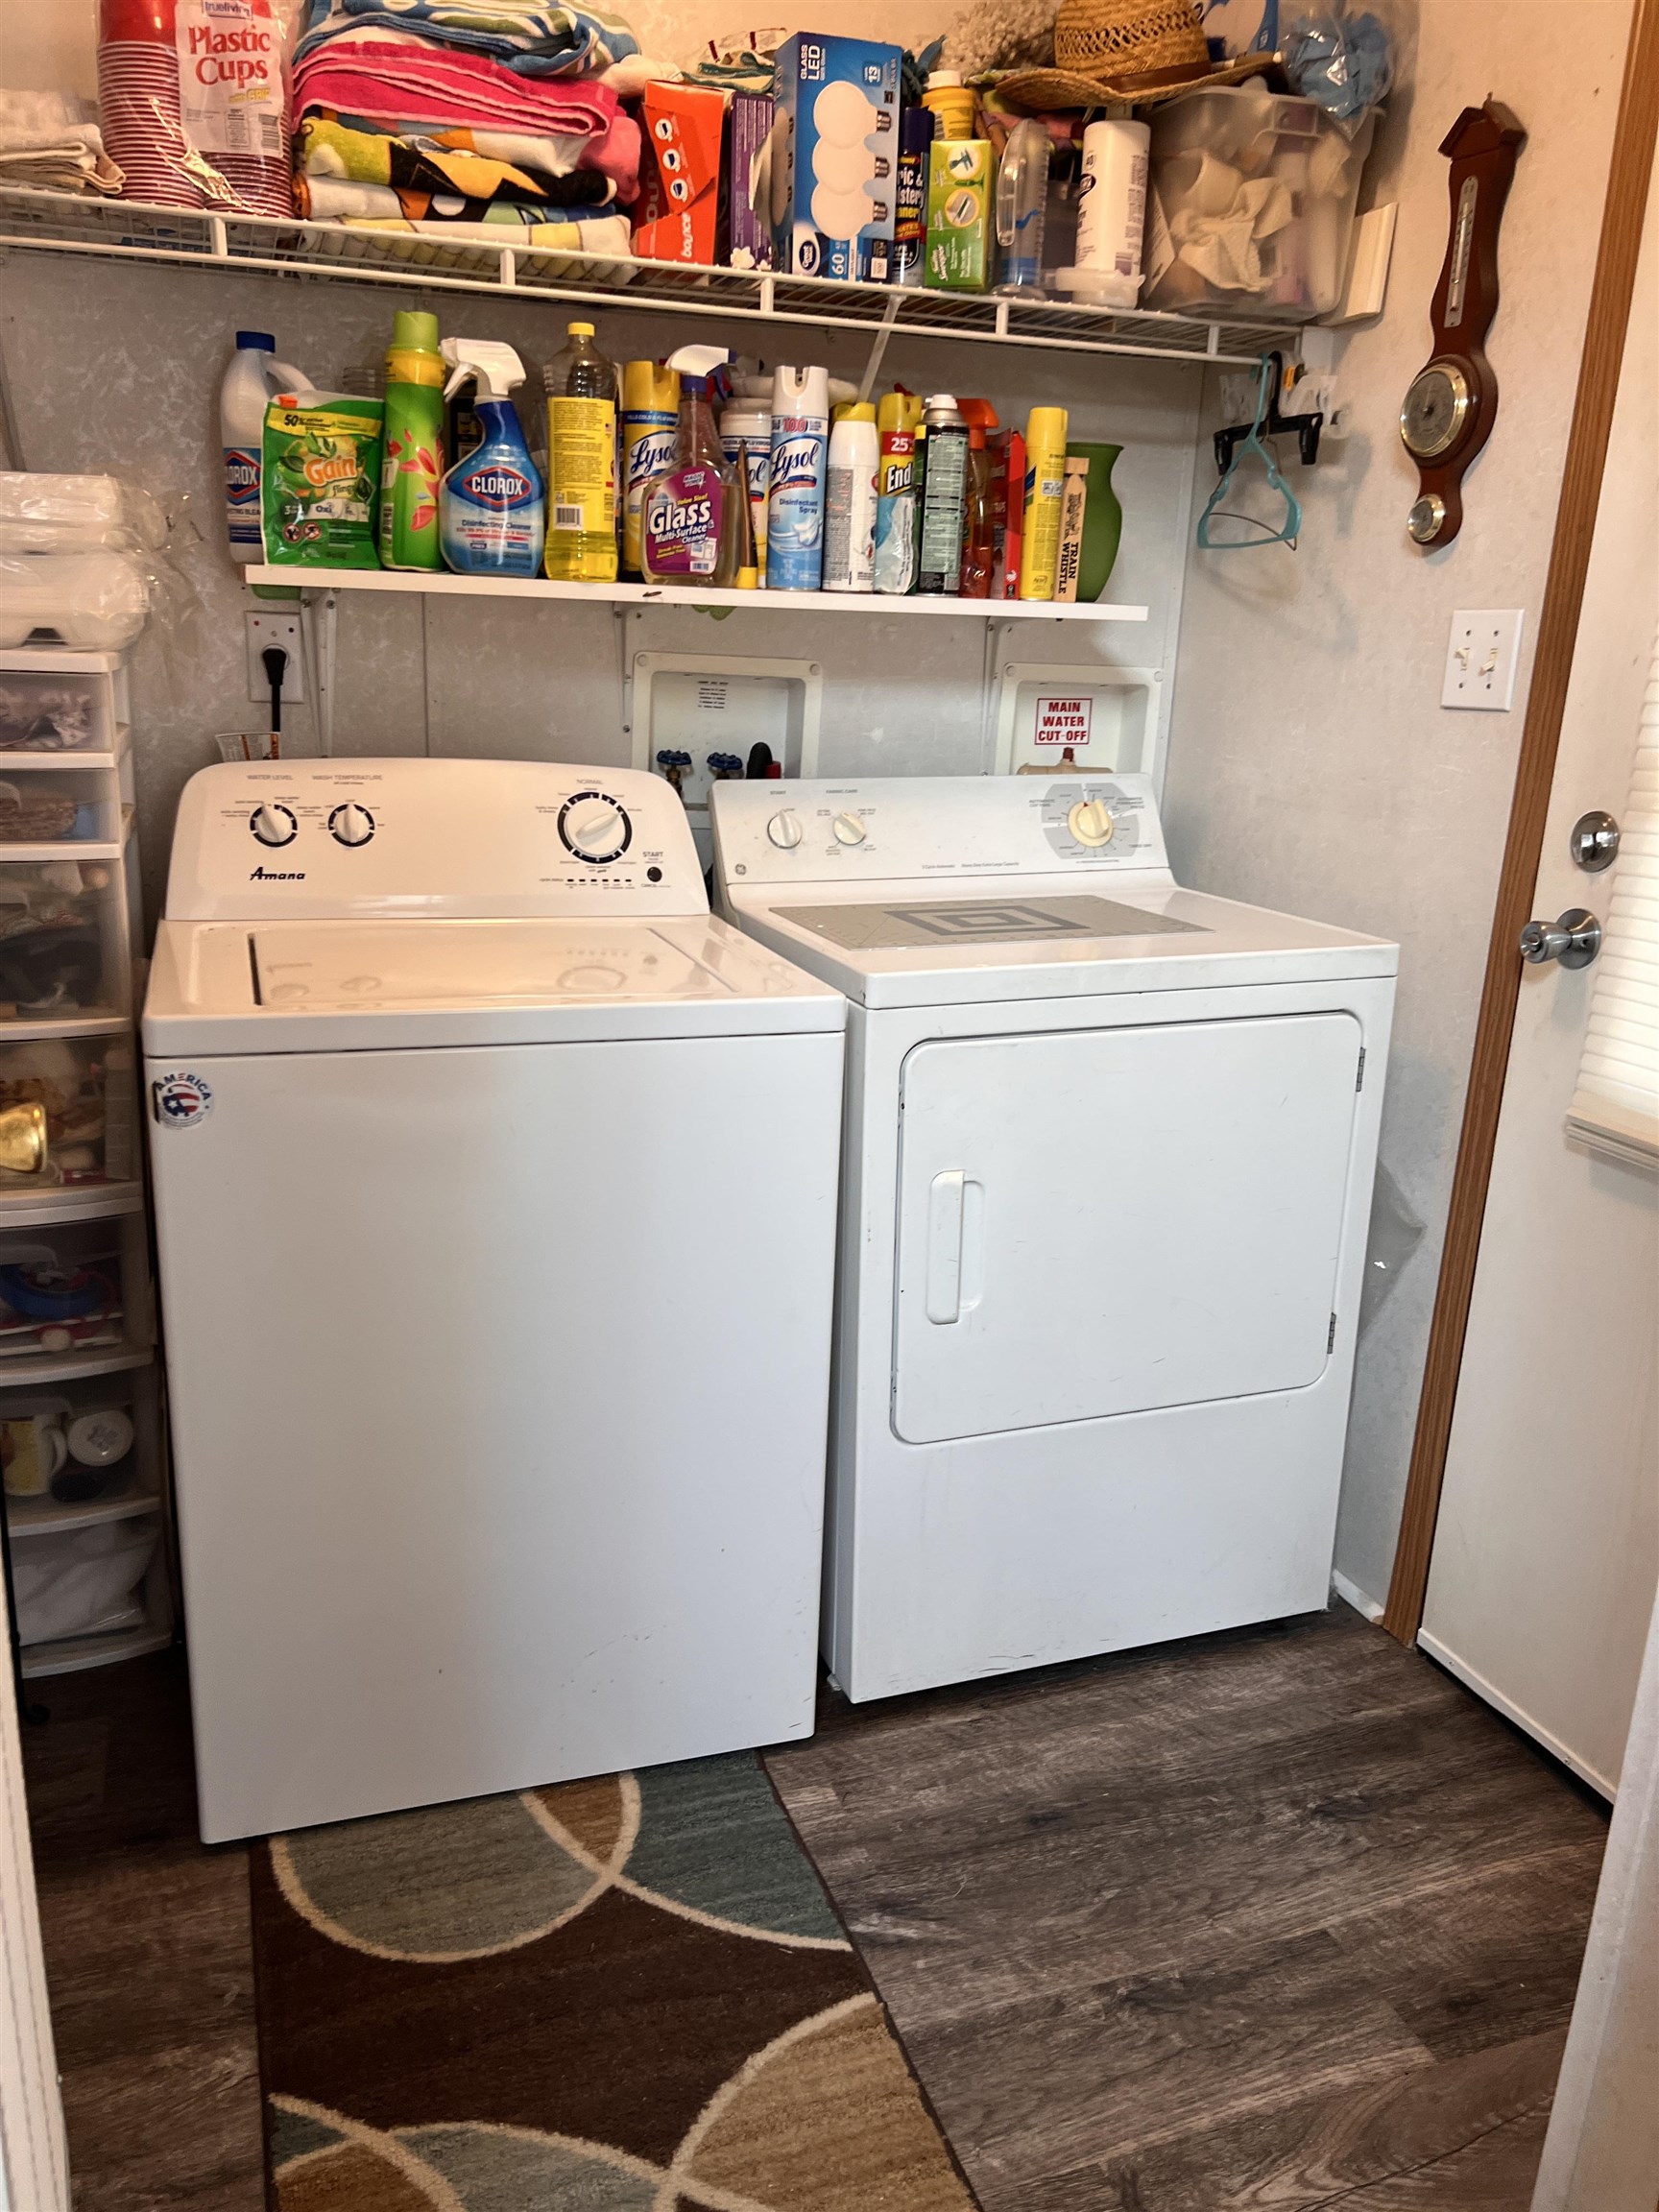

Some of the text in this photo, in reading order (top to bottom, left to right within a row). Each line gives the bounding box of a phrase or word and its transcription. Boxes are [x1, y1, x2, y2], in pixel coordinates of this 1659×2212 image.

[188, 24, 271, 55] Plastic
[196, 58, 269, 88] Cups
[800, 44, 808, 80] GLASS
[808, 45, 821, 81] LED
[897, 166, 914, 185] ric
[896, 206, 920, 219] aner
[681, 212, 693, 258] bounce
[831, 253, 845, 276] 60
[783, 417, 808, 433] 100
[304, 455, 357, 487] Gain
[769, 442, 819, 482] Lysol
[471, 476, 523, 495] CLOROX
[886, 462, 912, 494] End
[462, 519, 504, 529] Disinfecting
[649, 500, 711, 535] Glass
[655, 523, 708, 543] Multi-Surface
[1058, 541, 1070, 595] WHISTLE
[1068, 542, 1078, 579] TRAIN
[1048, 702, 1081, 712] MAIN
[1043, 716, 1085, 727] WATER
[1038, 731, 1087, 741] CUT-OFF
[250, 866, 306, 880] Amana
[152, 1072, 211, 1100] AMERICA
